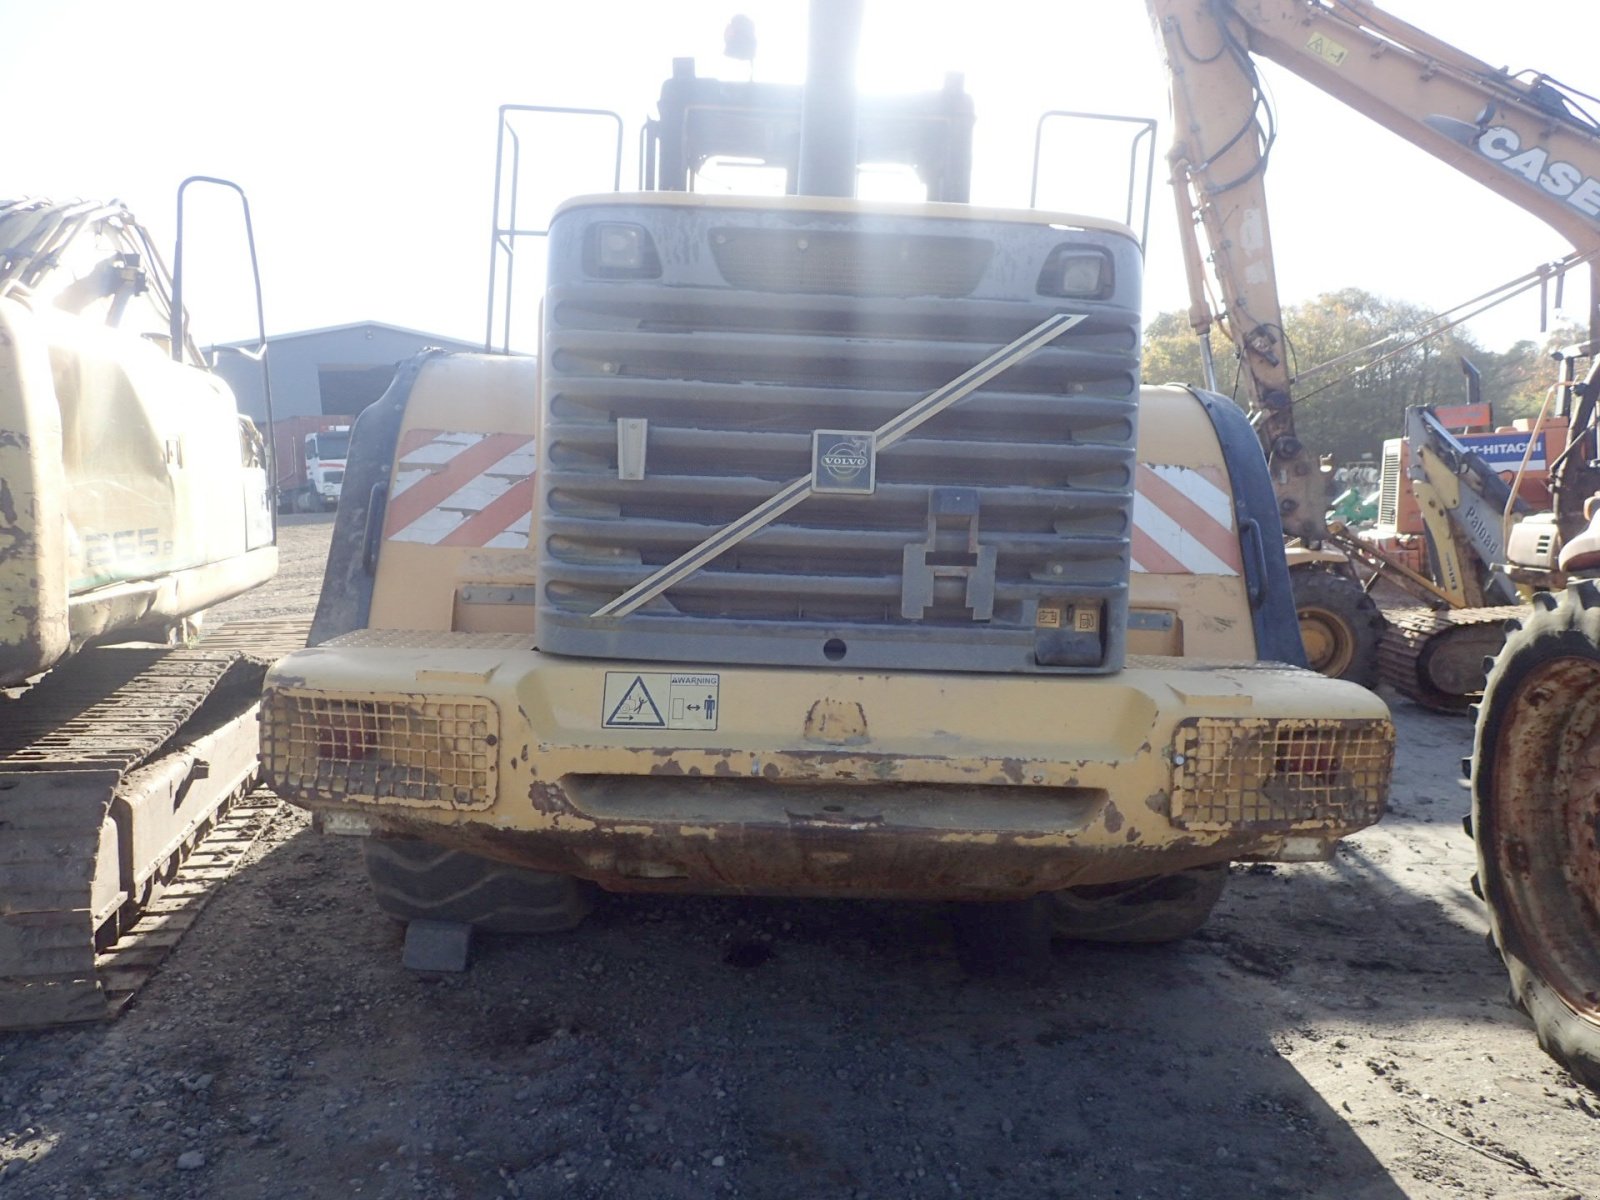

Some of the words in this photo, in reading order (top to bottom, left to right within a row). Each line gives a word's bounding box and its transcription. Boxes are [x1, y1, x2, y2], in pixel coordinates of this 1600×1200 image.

[1479, 126, 1600, 216] CASE
[824, 457, 865, 466] VOLVO
[677, 677, 717, 685] WARNING
